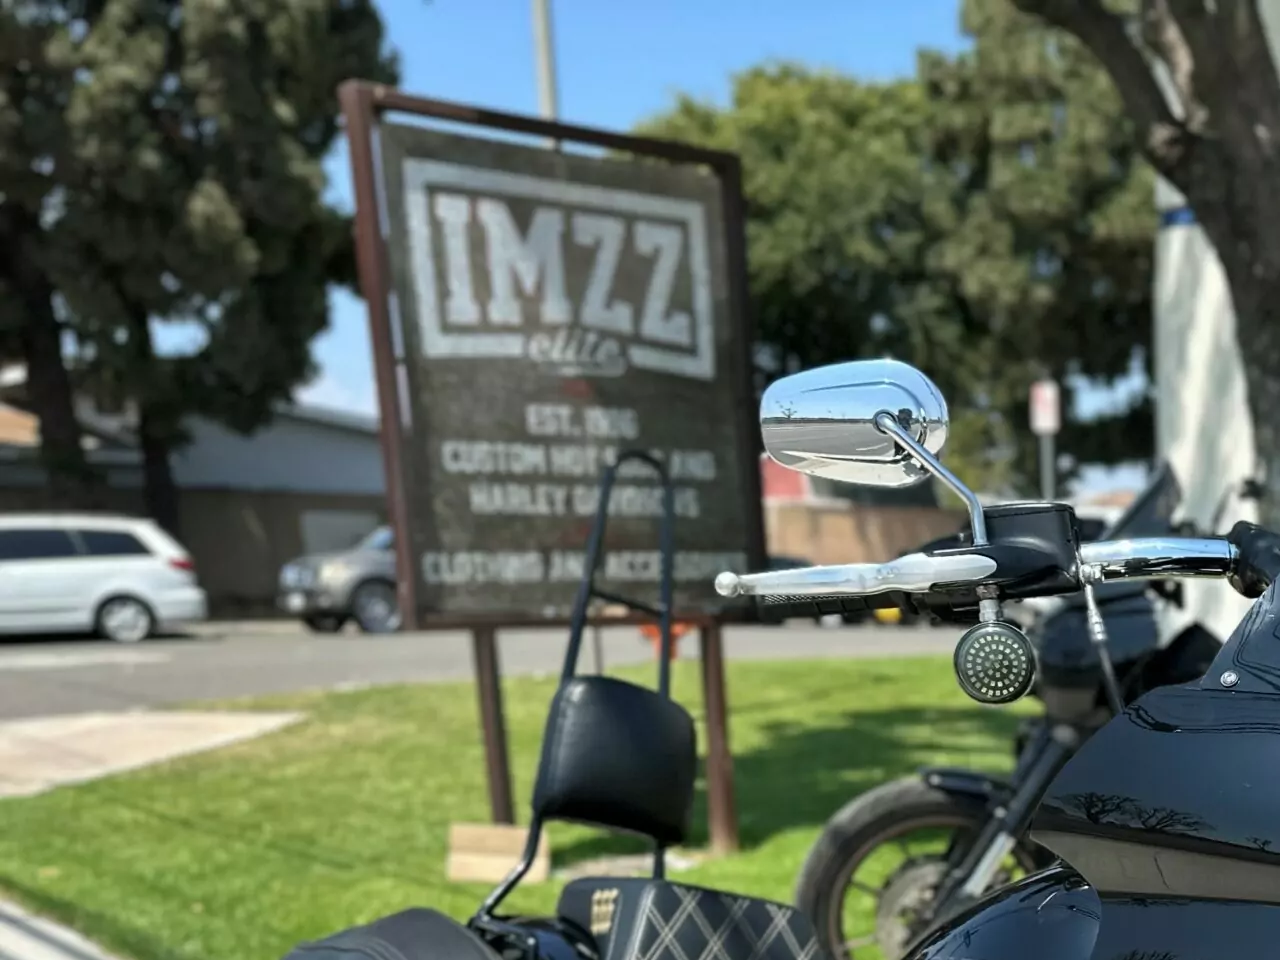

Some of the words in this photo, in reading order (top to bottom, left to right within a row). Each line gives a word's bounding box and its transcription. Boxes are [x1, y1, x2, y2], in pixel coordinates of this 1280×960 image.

[433, 193, 693, 346] IMZZ
[528, 325, 624, 370] elite
[525, 404, 583, 436] EST.
[440, 441, 548, 475] CUSTOM
[549, 446, 600, 477] HOT
[469, 483, 568, 517] HARLEY
